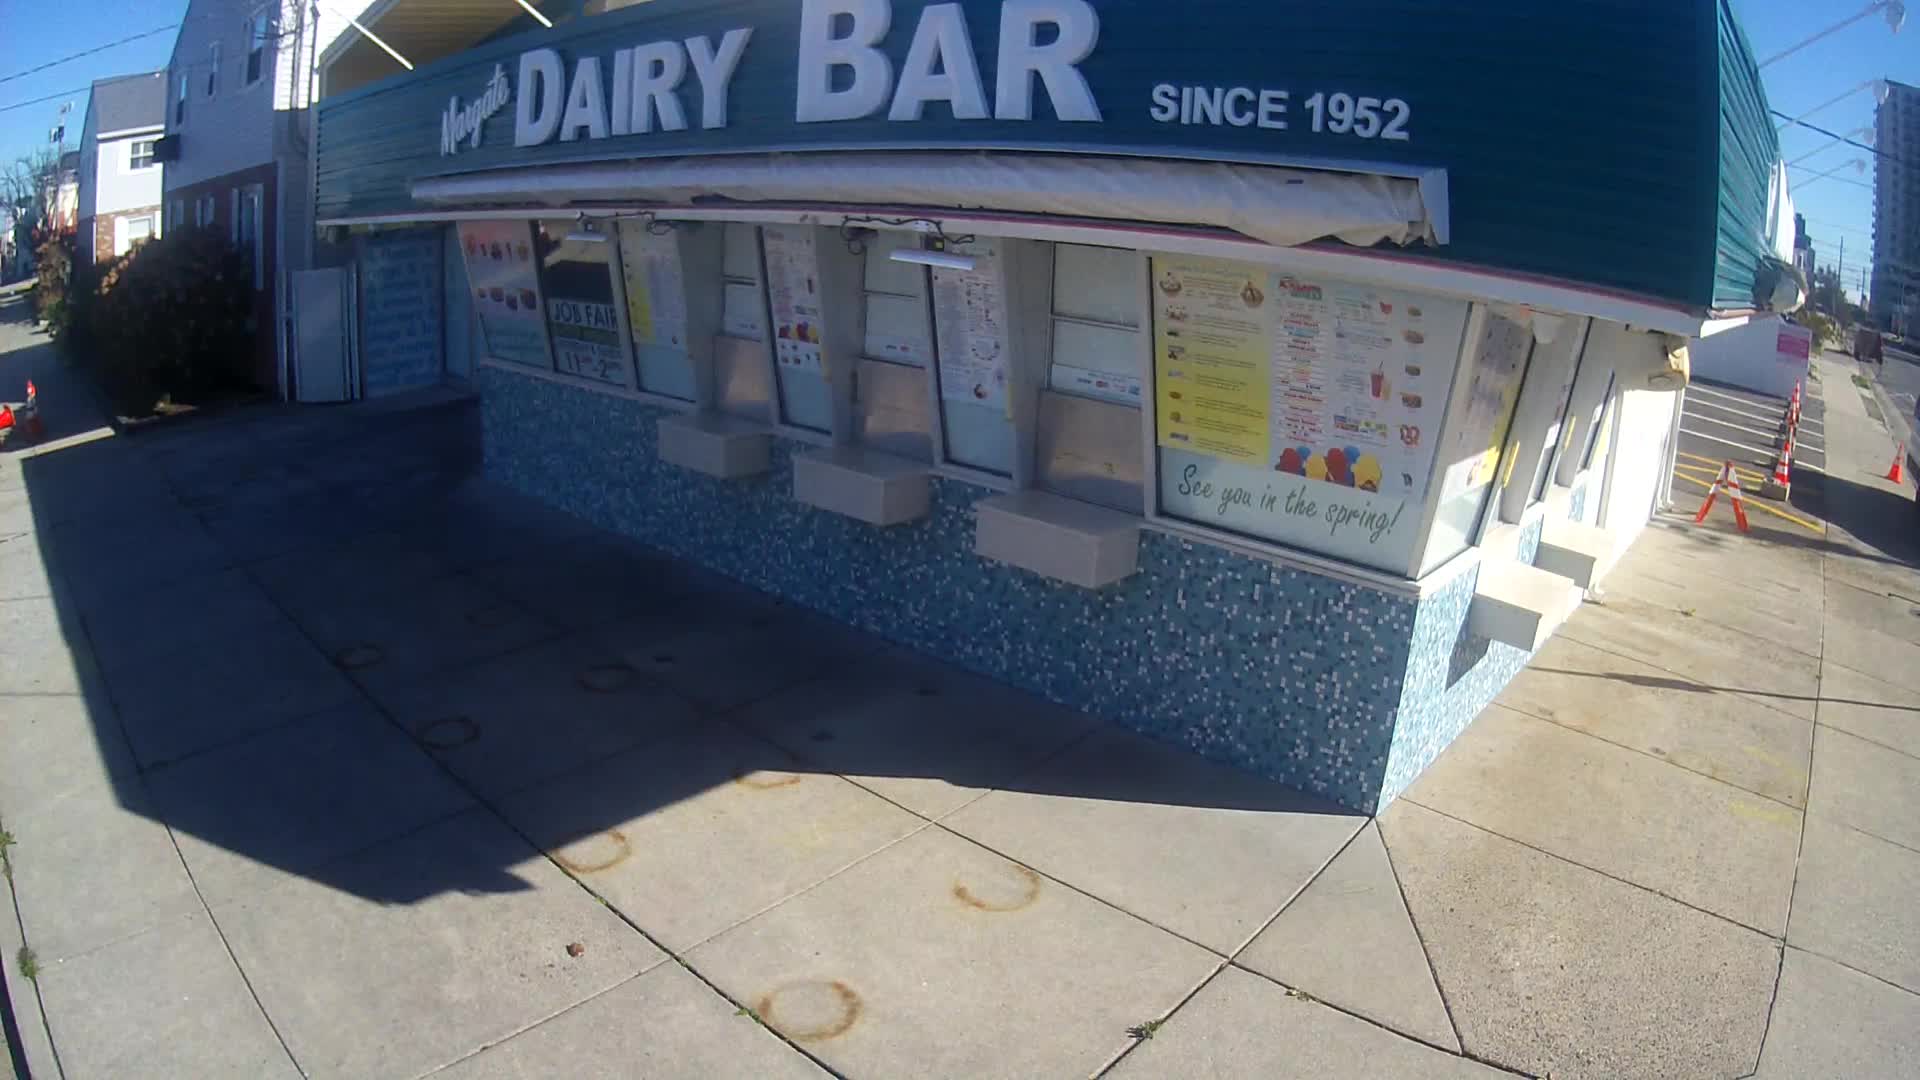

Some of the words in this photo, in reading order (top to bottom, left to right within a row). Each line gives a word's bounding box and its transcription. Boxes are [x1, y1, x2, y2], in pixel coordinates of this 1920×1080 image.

[440, 63, 511, 157] Margate
[514, 27, 755, 148] DAIRY
[796, 0, 1102, 123] BAR
[1150, 84, 1289, 130] SINCE
[1304, 92, 1411, 141] 1952
[554, 302, 583, 324] JOB
[585, 304, 618, 329] FAIR
[1178, 464, 1213, 499] See
[1218, 485, 1252, 516] you
[1259, 484, 1278, 512] in
[1284, 485, 1318, 517] the
[1325, 499, 1406, 543] spring!
